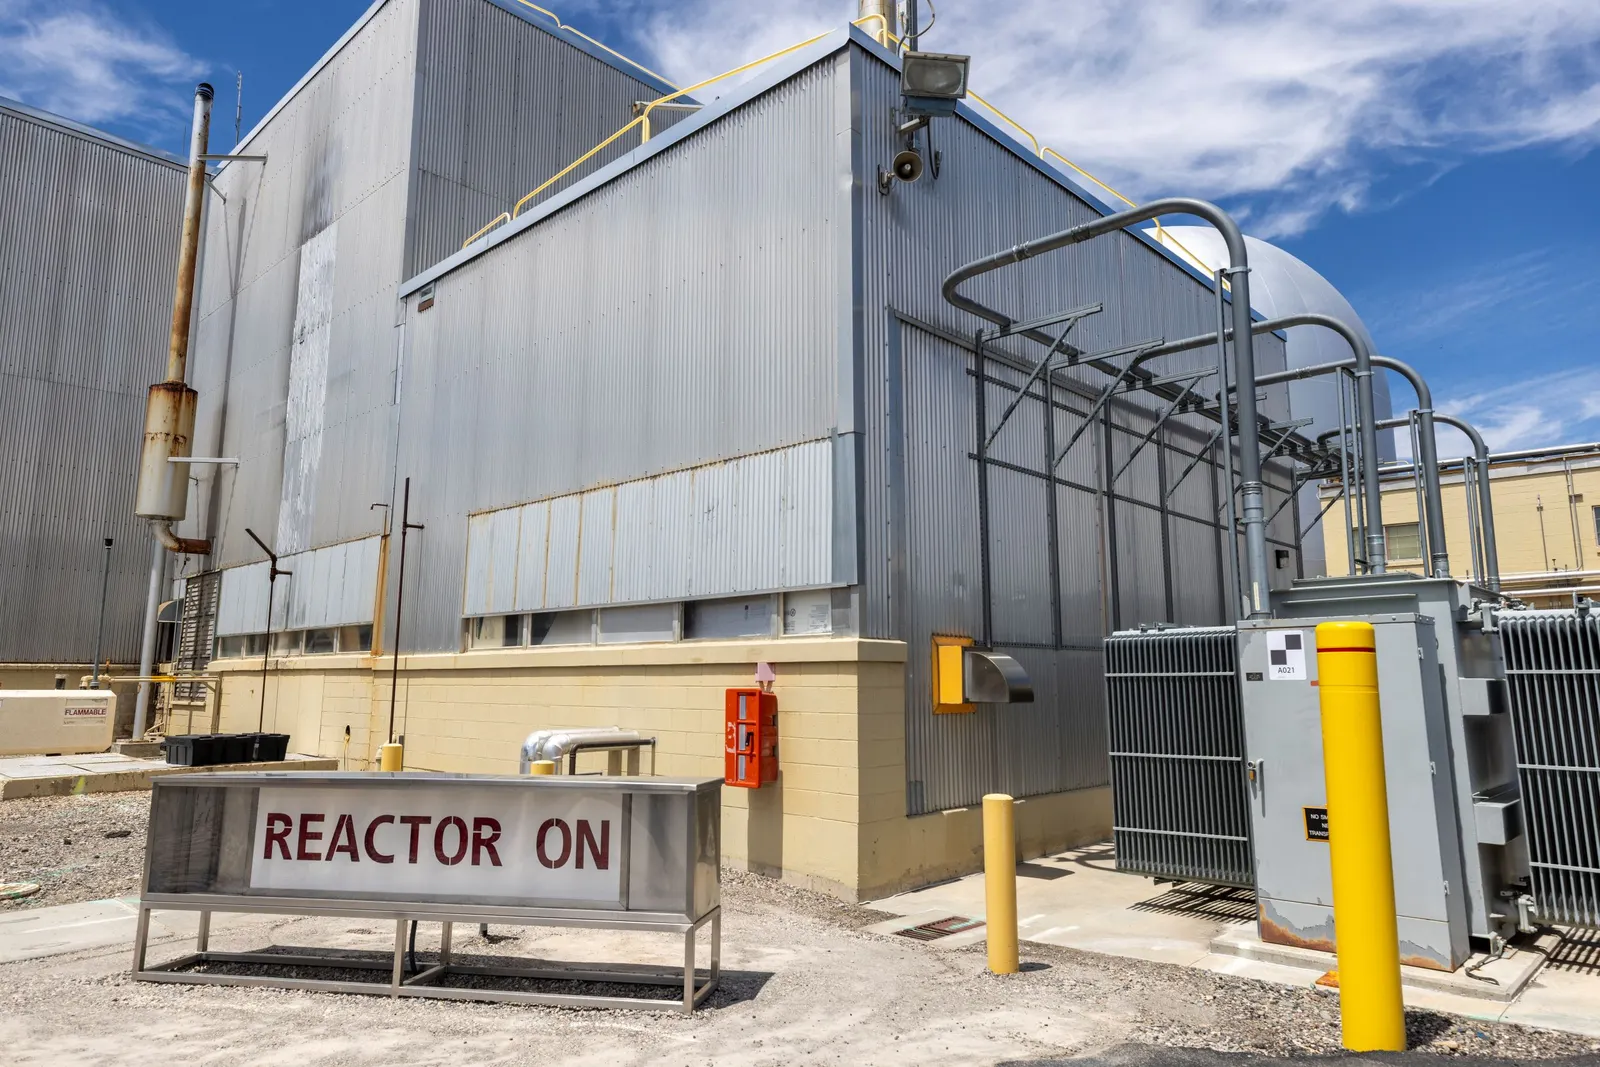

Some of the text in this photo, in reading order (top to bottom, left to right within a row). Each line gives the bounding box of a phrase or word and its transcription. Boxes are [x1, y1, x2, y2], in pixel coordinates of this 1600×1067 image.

[1278, 666, 1295, 674] A021
[64, 708, 107, 716] FLAMMABLE
[263, 812, 610, 870] REACTOR ON
